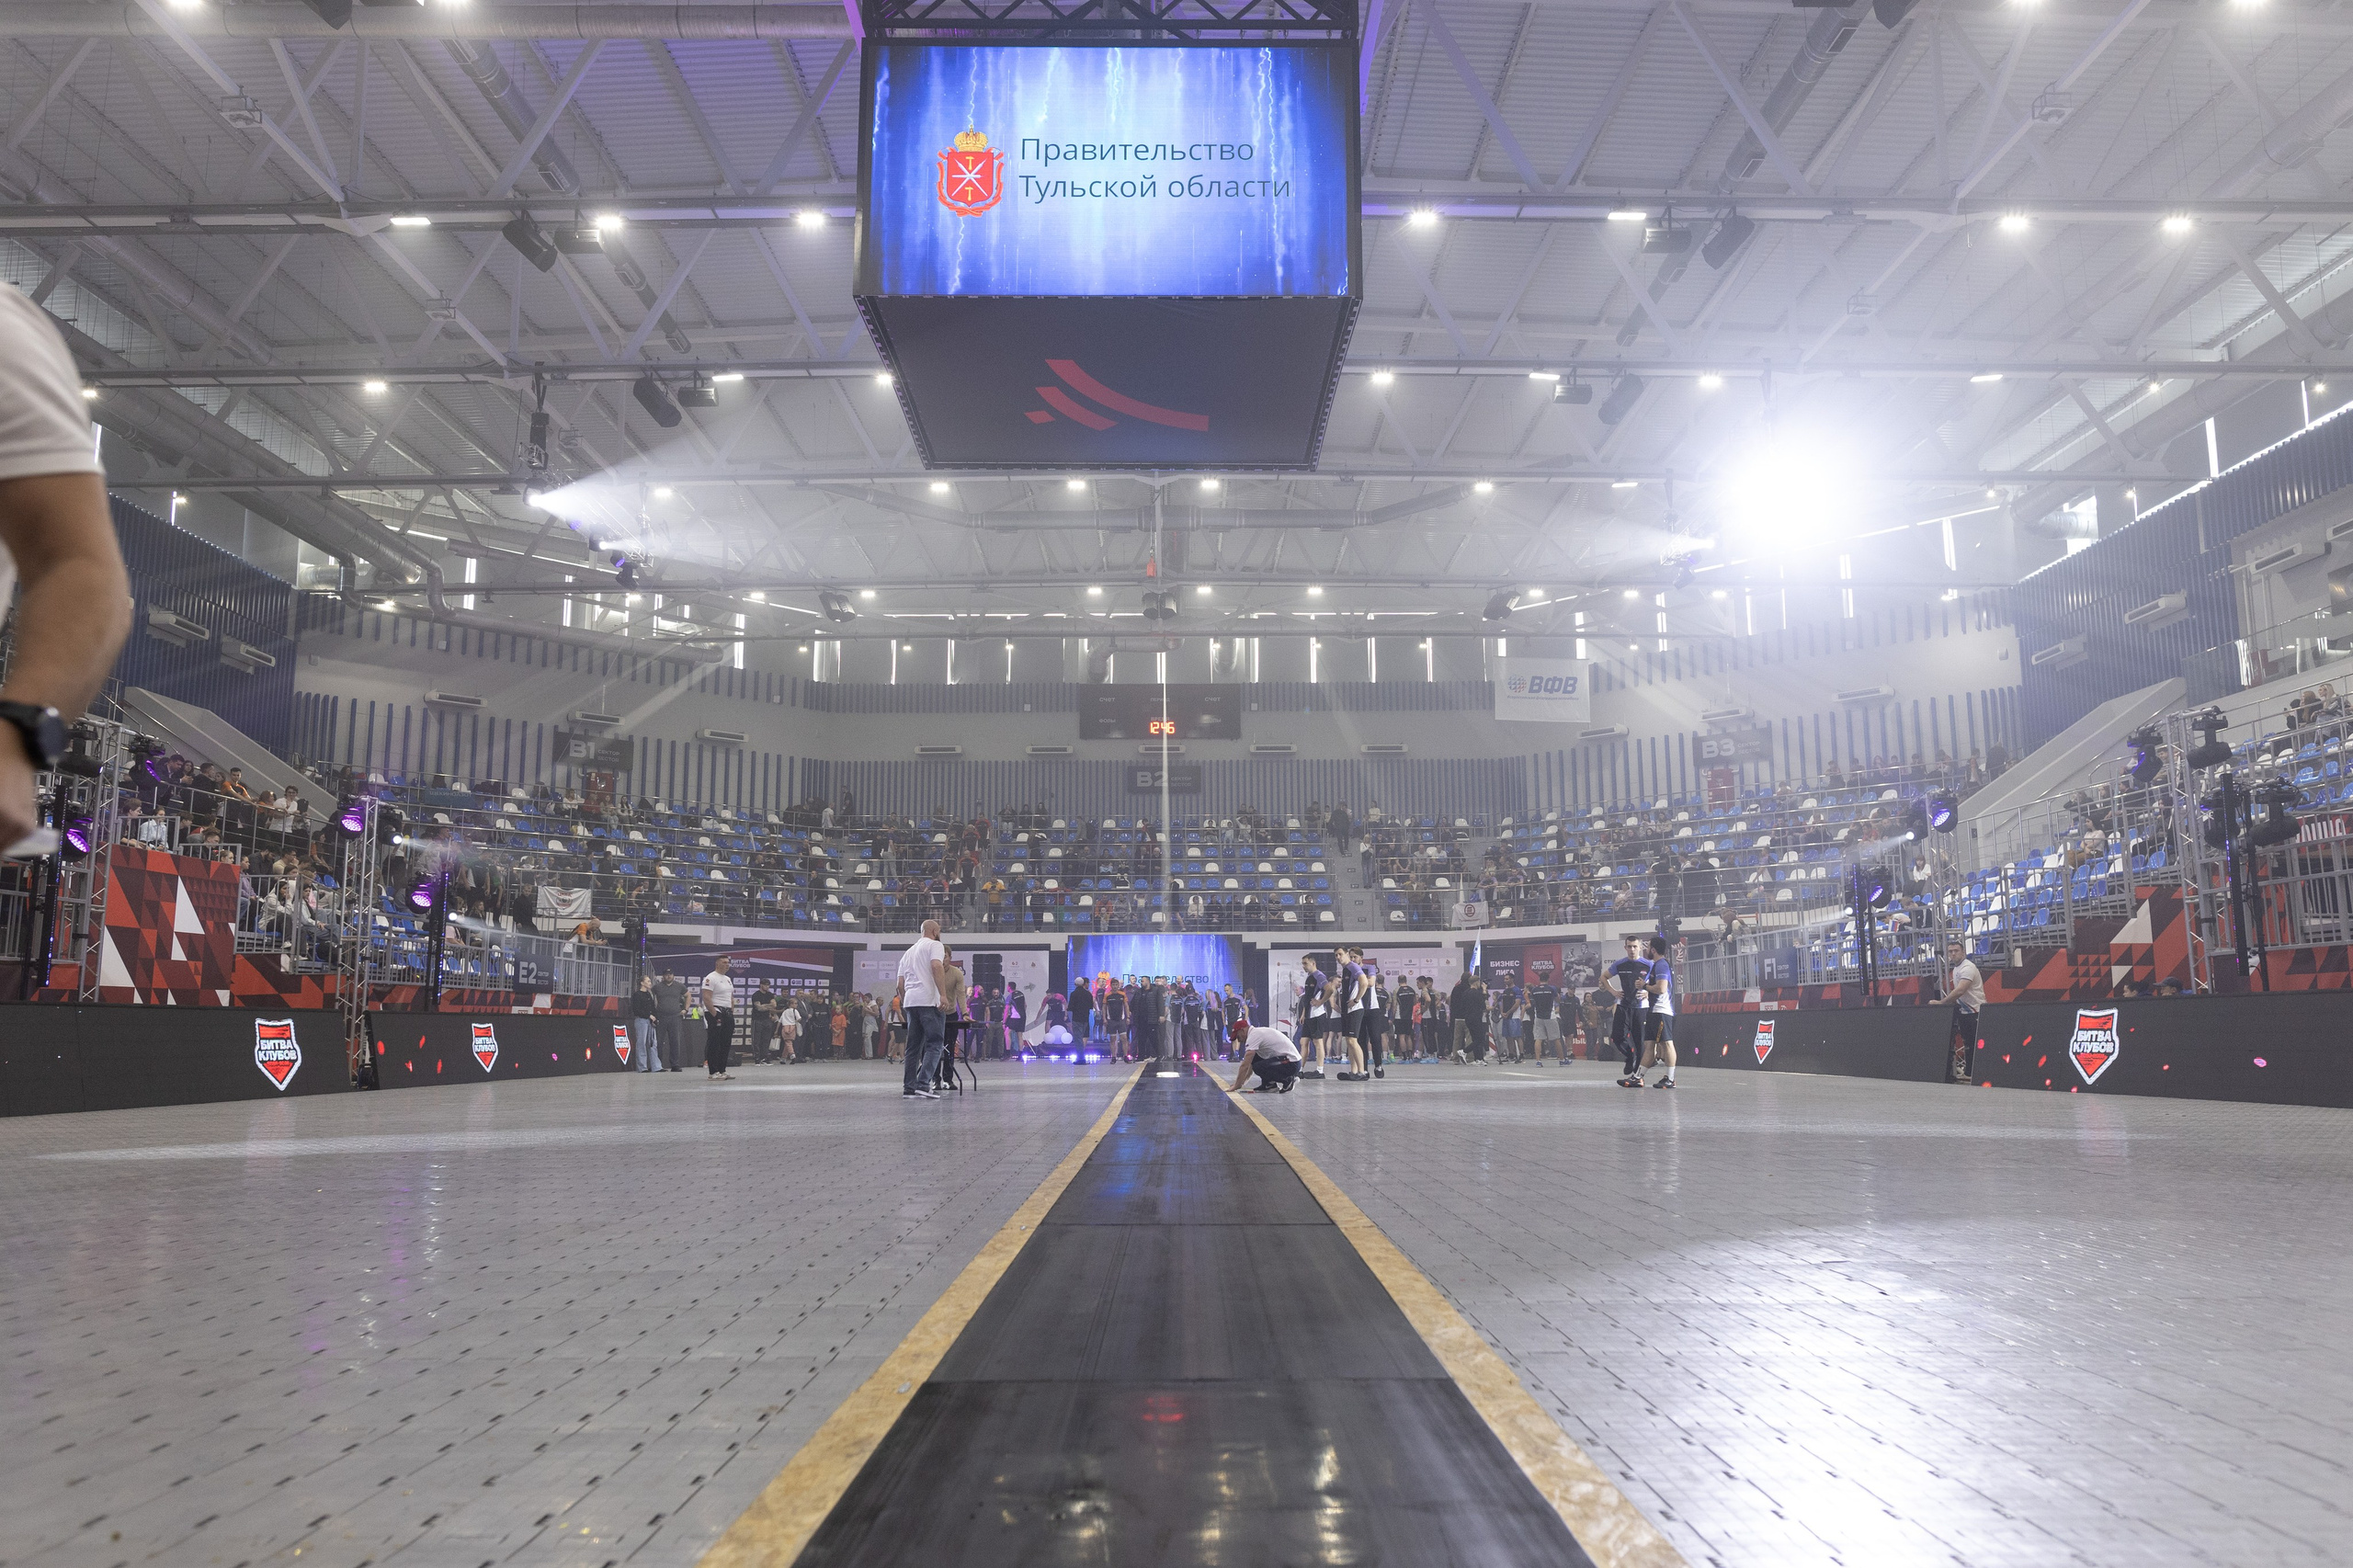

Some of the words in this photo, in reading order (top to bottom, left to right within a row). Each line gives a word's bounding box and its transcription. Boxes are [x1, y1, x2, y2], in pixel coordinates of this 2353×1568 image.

[1021, 138, 1253, 167] Правительство
[1018, 174, 1156, 204] Тульской
[1168, 175, 1290, 198] области
[1528, 676, 1578, 694] ВФВ
[1490, 960, 1520, 968] БИЗНЕС
[1765, 958, 1777, 981] F1
[519, 960, 538, 984] E2
[2077, 1030, 2112, 1041] БИТВА
[260, 1039, 294, 1050] БИТВА
[2073, 1041, 2115, 1053] КЛУБОВ
[257, 1050, 298, 1062] КЛУБОВ
